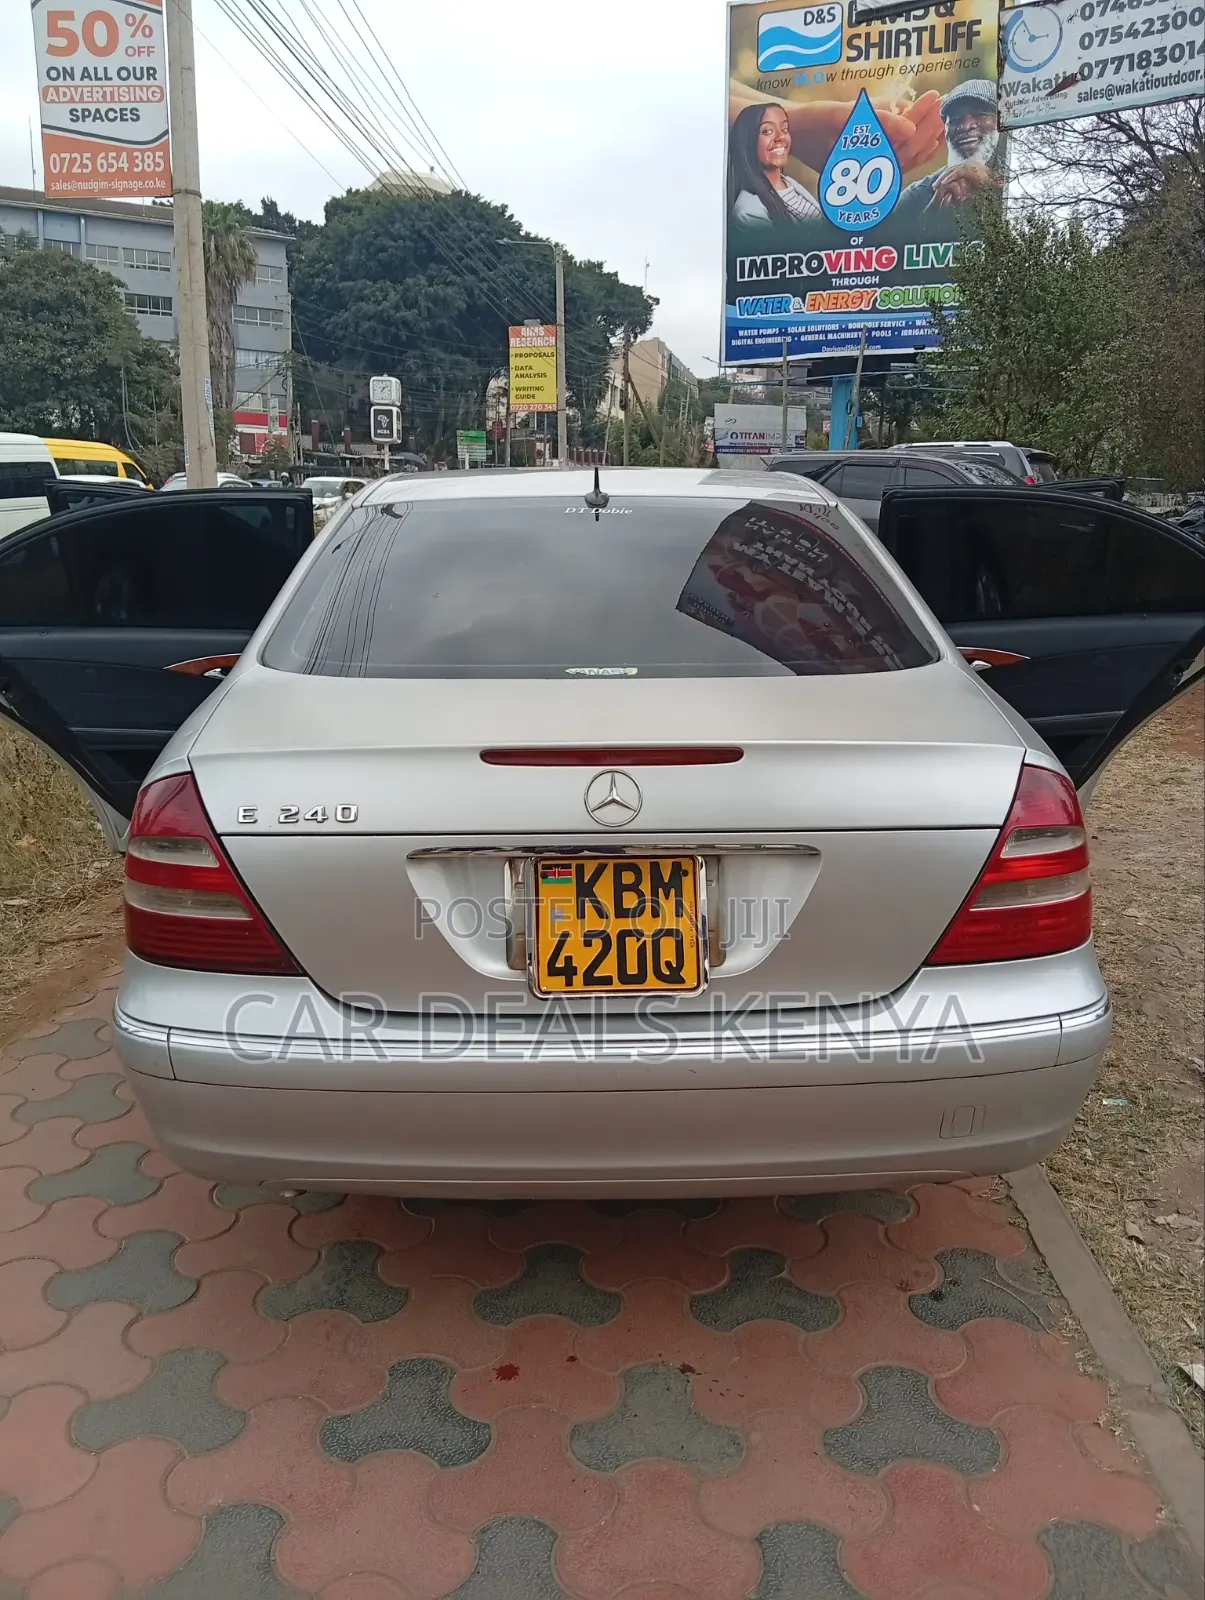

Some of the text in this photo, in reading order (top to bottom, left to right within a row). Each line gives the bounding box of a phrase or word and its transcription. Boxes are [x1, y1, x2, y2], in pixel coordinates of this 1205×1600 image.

[804, 6, 836, 26] D&S
[1079, 6, 1205, 51] 07542300
[846, 18, 982, 63] SHIRTLIFF
[124, 46, 155, 57] OFF
[46, 66, 158, 82] ON ALL OUR
[756, 77, 791, 91] know
[840, 64, 894, 82] through
[899, 56, 980, 75] experience
[1077, 68, 1205, 102] sales@wakatioutdoor.
[46, 86, 161, 102] ADVERTISING
[69, 107, 140, 123] SPACES
[853, 124, 871, 134] EST
[841, 134, 881, 150] 1946
[50, 151, 164, 174] 0725 654 385
[824, 156, 895, 207] 80
[838, 208, 880, 223] YEARS
[850, 237, 863, 245] OF
[737, 246, 896, 282] IMPROVING
[831, 275, 879, 286] THROUGH
[737, 294, 792, 318] WATER
[792, 299, 804, 310] &
[804, 288, 877, 313] ENERGY
[521, 326, 545, 337] AIMS
[807, 324, 839, 332] SOLUTIONS
[880, 320, 906, 328] SERVICE
[510, 336, 556, 347] RESEARCH
[731, 338, 753, 346] DIGITAL
[800, 333, 826, 342] GENERAL
[871, 330, 892, 338] POOLS
[591, 507, 633, 515] Dobie
[237, 803, 359, 824] E 240
[575, 861, 684, 920] KBM
[546, 928, 686, 987] 420Q
